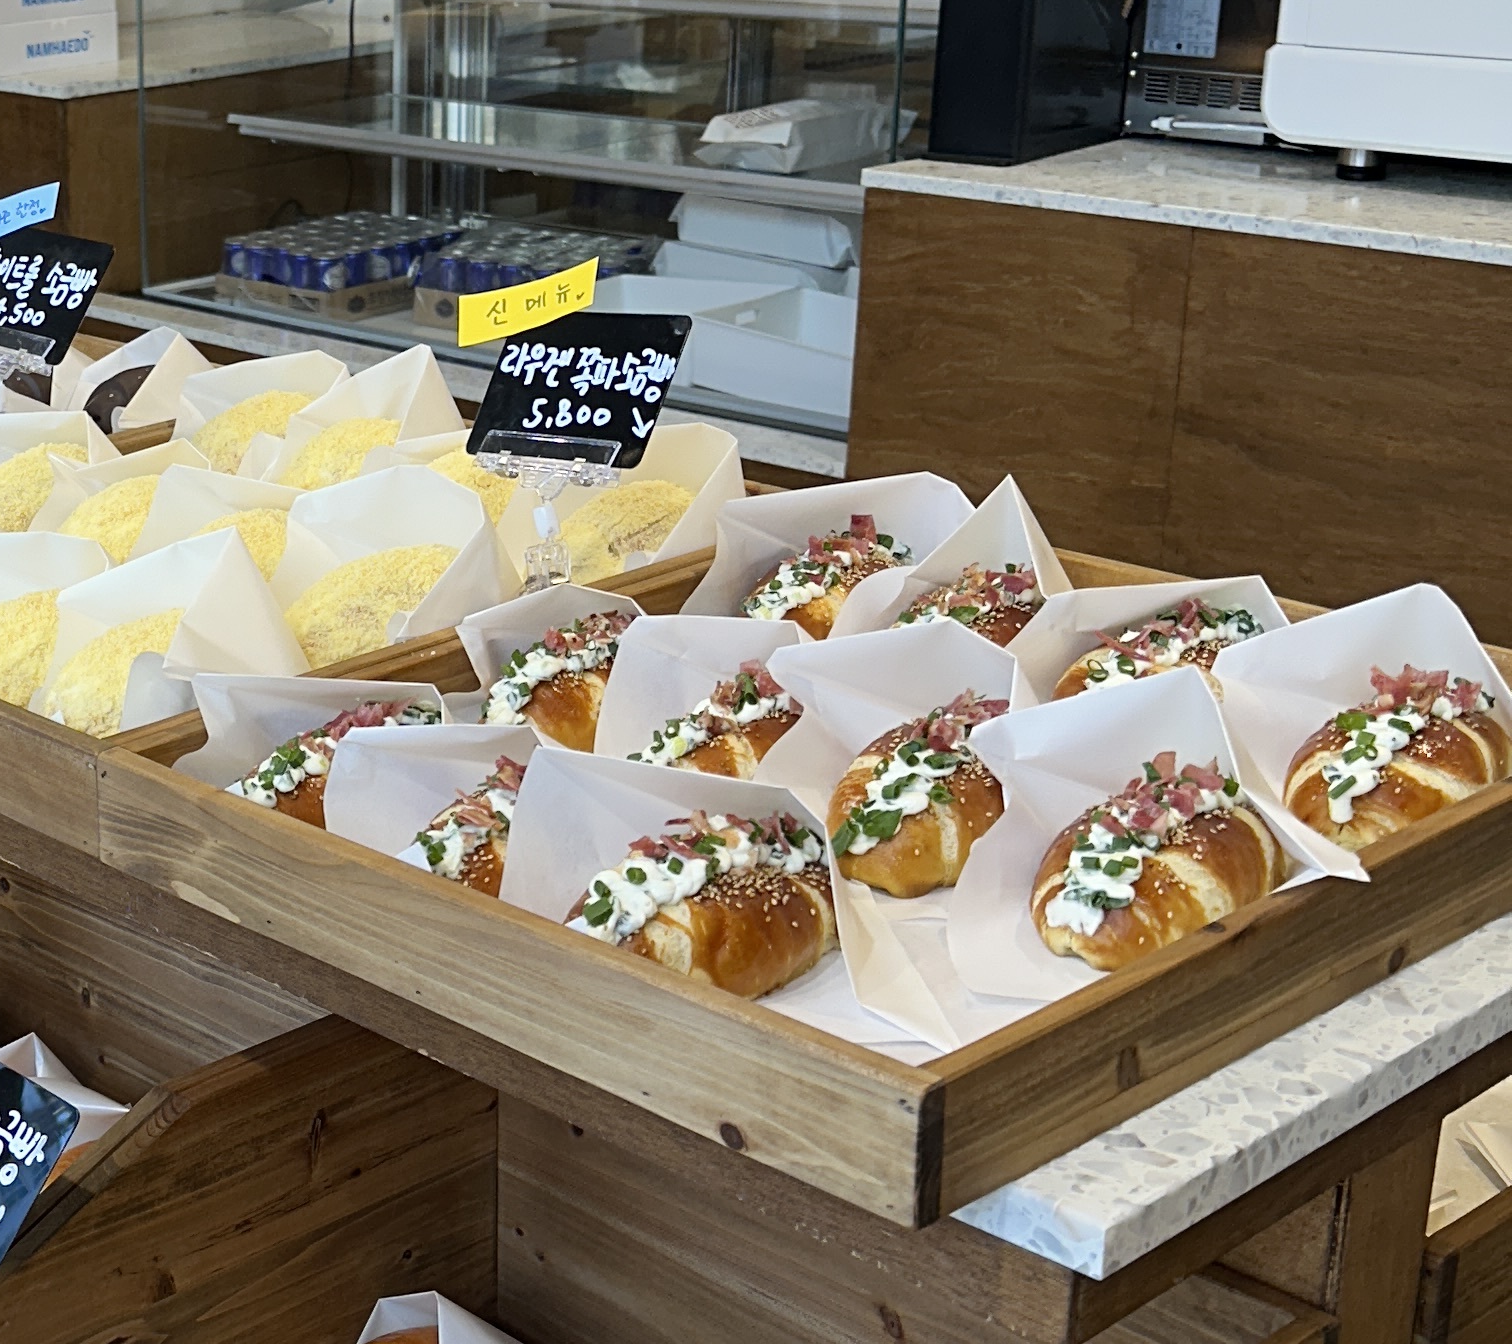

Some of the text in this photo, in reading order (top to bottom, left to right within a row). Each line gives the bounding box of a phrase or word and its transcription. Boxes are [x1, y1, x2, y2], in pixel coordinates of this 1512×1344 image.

[26, 37, 89, 58] NAMHAEDO
[41, 261, 97, 310] 소금빵
[486, 299, 507, 325] 신
[500, 343, 574, 387] 라우겐
[522, 398, 611, 428] 5,800
